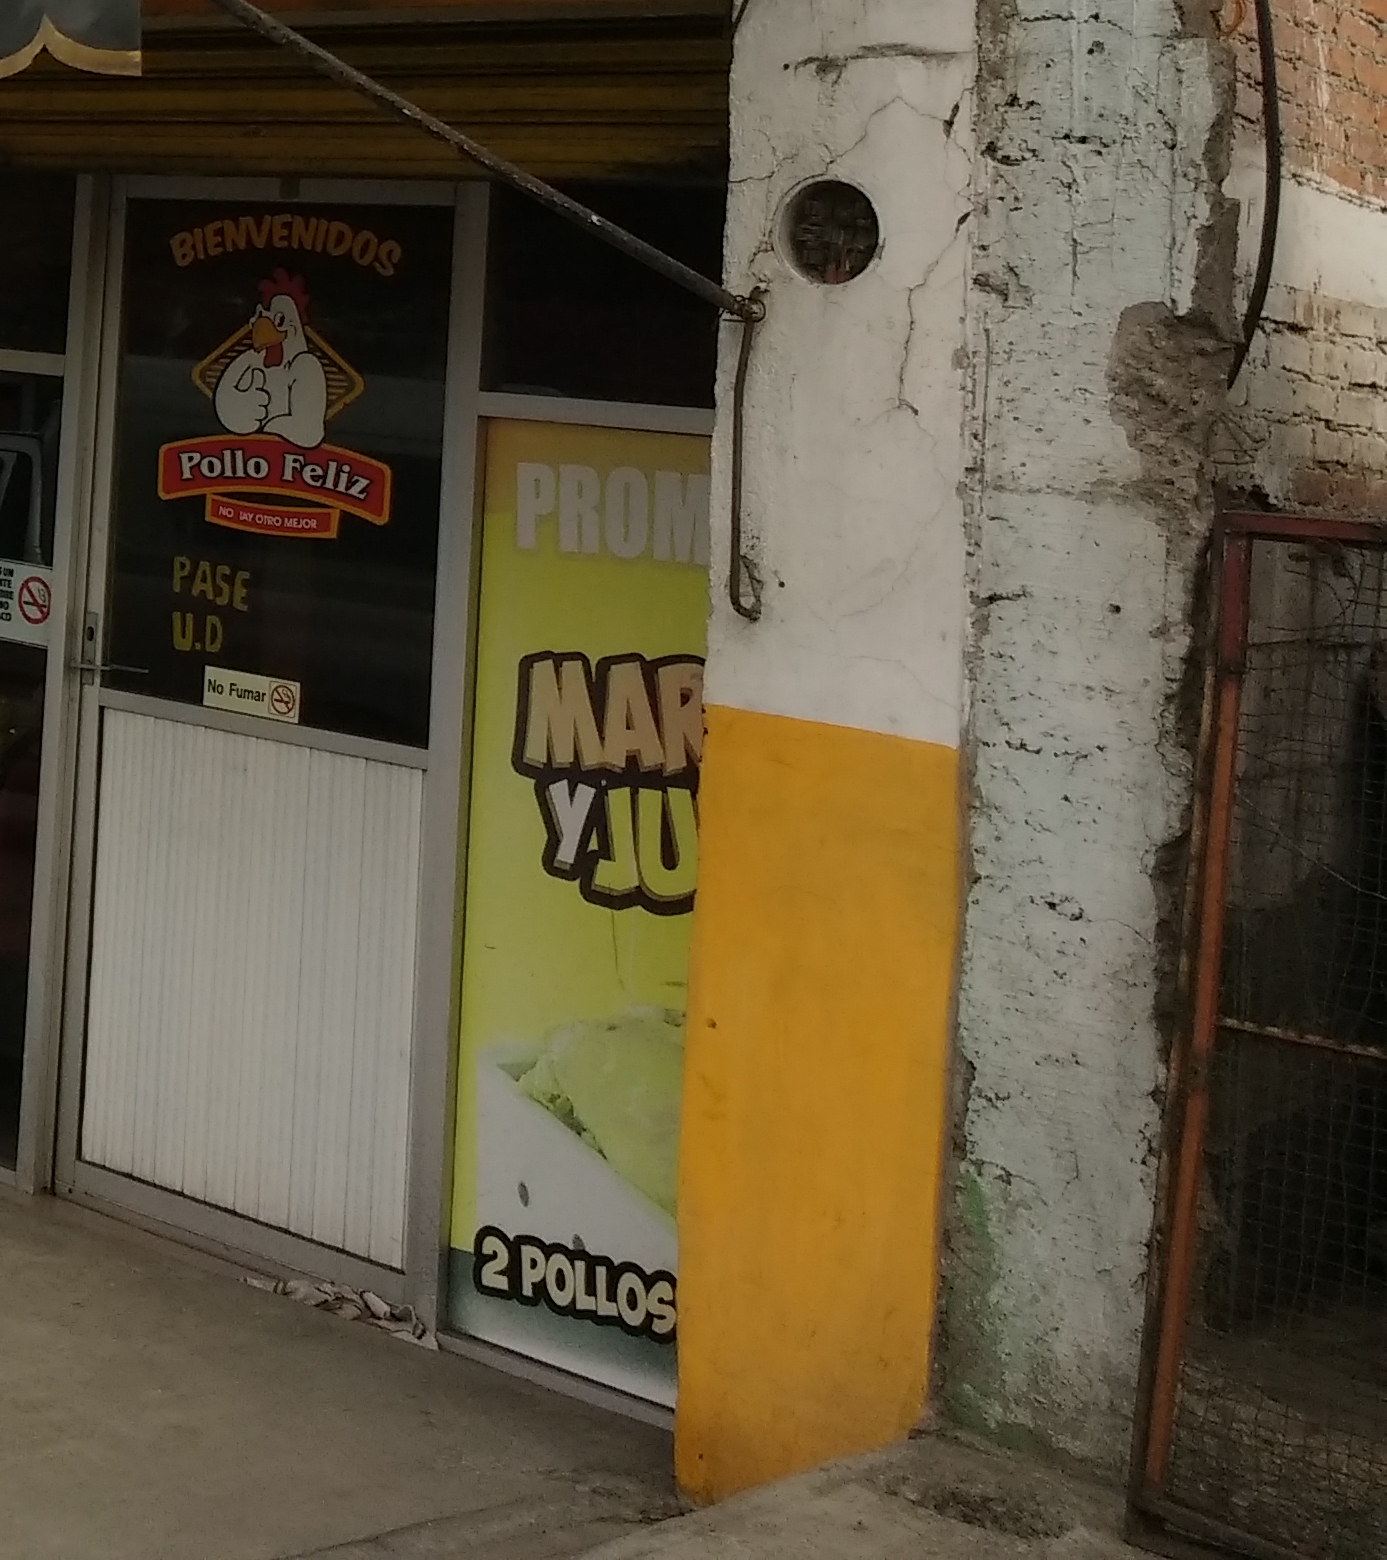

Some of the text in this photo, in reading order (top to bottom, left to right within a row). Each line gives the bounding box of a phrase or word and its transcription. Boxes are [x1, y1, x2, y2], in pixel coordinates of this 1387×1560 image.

[170, 213, 402, 277] BIENVENIDOS
[179, 449, 371, 500] Pollo Feliz
[218, 506, 234, 518] NO
[255, 513, 282, 527] OTRO
[284, 517, 317, 529] MEJOR
[3, 567, 14, 578] UN
[172, 556, 251, 611] PASE
[207, 679, 266, 703] No Fumar
[544, 779, 595, 871] Y
[481, 1235, 676, 1334] 2 POLLOS
